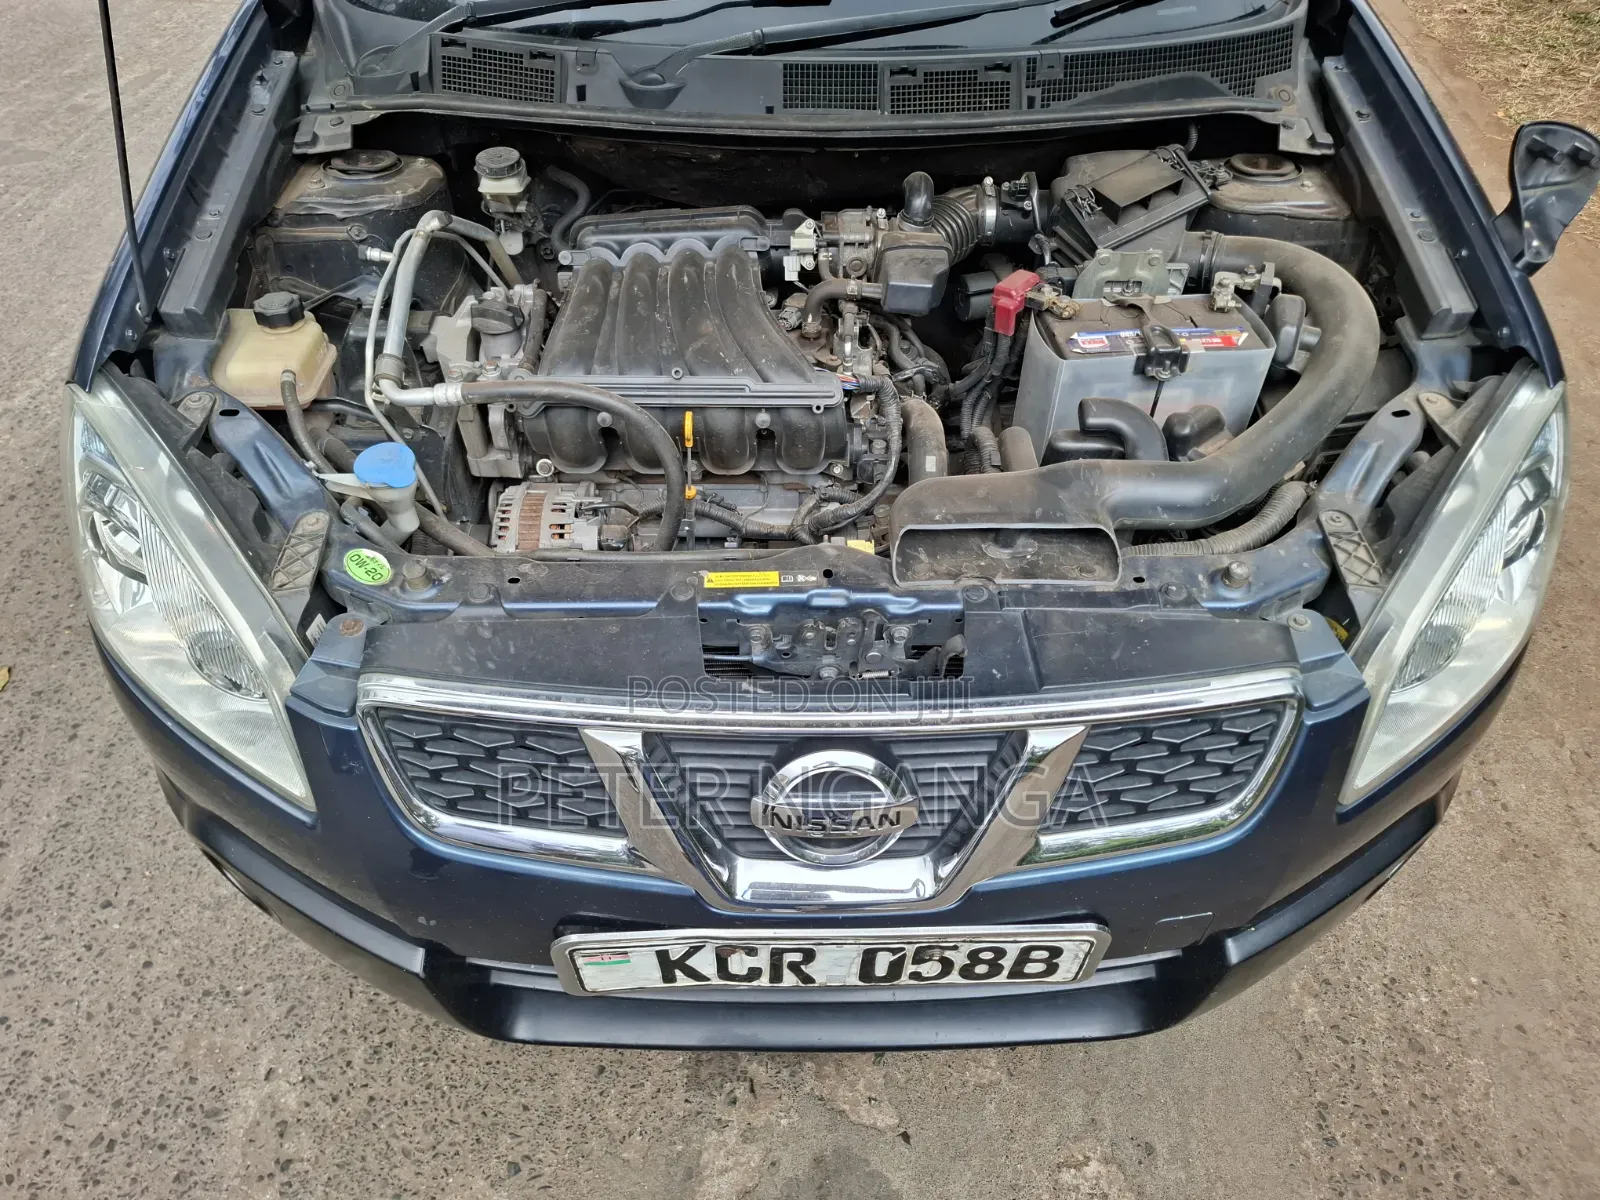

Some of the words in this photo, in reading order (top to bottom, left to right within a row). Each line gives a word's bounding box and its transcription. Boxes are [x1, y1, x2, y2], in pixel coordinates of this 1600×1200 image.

[770, 810, 902, 832] NISSAN
[655, 944, 816, 985] KCR
[858, 944, 1061, 984] 058B
